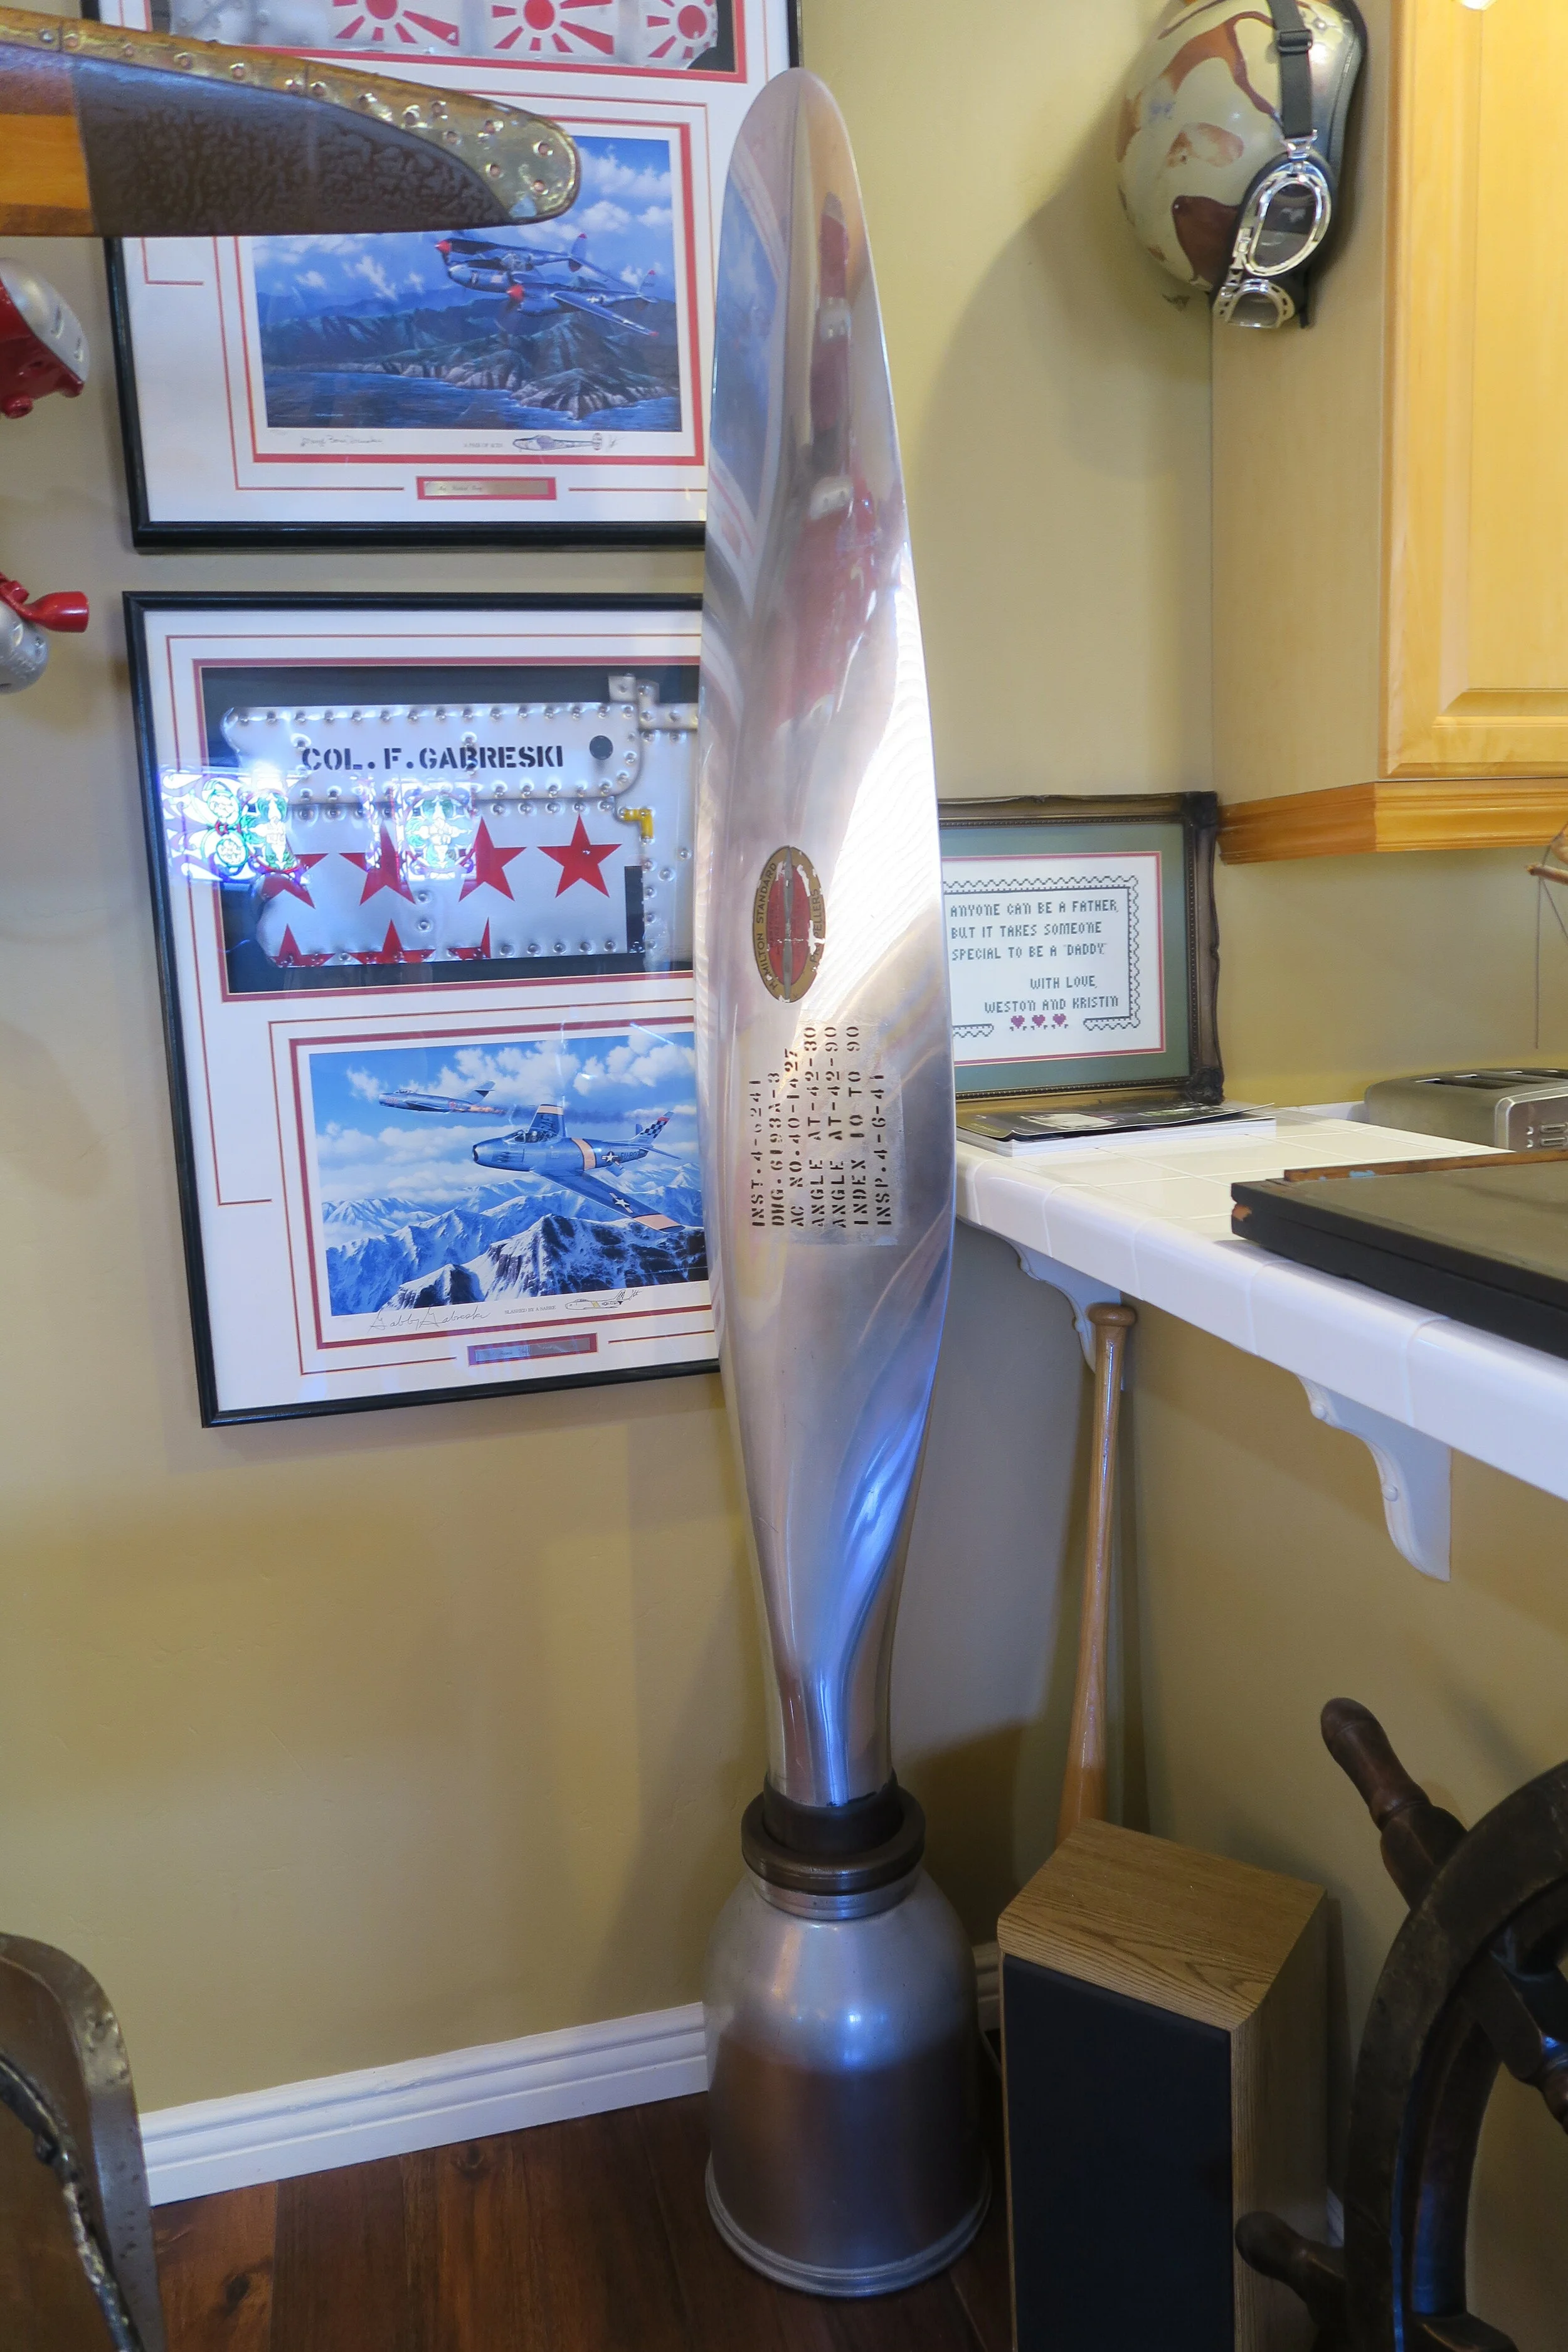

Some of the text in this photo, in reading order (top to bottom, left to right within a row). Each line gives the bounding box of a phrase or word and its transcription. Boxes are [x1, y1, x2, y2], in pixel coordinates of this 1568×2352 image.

[950, 899, 1119, 918] ANYONE CAN BE A FATHER,
[756, 862, 778, 990] HMILTON STANDARD
[951, 921, 1101, 939] BUT IT TAKES SOMEONE
[952, 947, 1001, 961] SPECIAL
[1008, 946, 1022, 958] TO
[1029, 946, 1043, 958] BE
[1050, 945, 1057, 956] A
[1030, 975, 1098, 989] WITH LOVE,
[985, 995, 1118, 1013] WESTON AND KRISTIN
[846, 1027, 861, 1052] 90
[847, 1071, 862, 1097] TO
[808, 1159, 825, 1227] ANGLE
[829, 1160, 847, 1228] ANGLE
[850, 1159, 869, 1226] INDEX
[790, 1205, 804, 1227] AC
